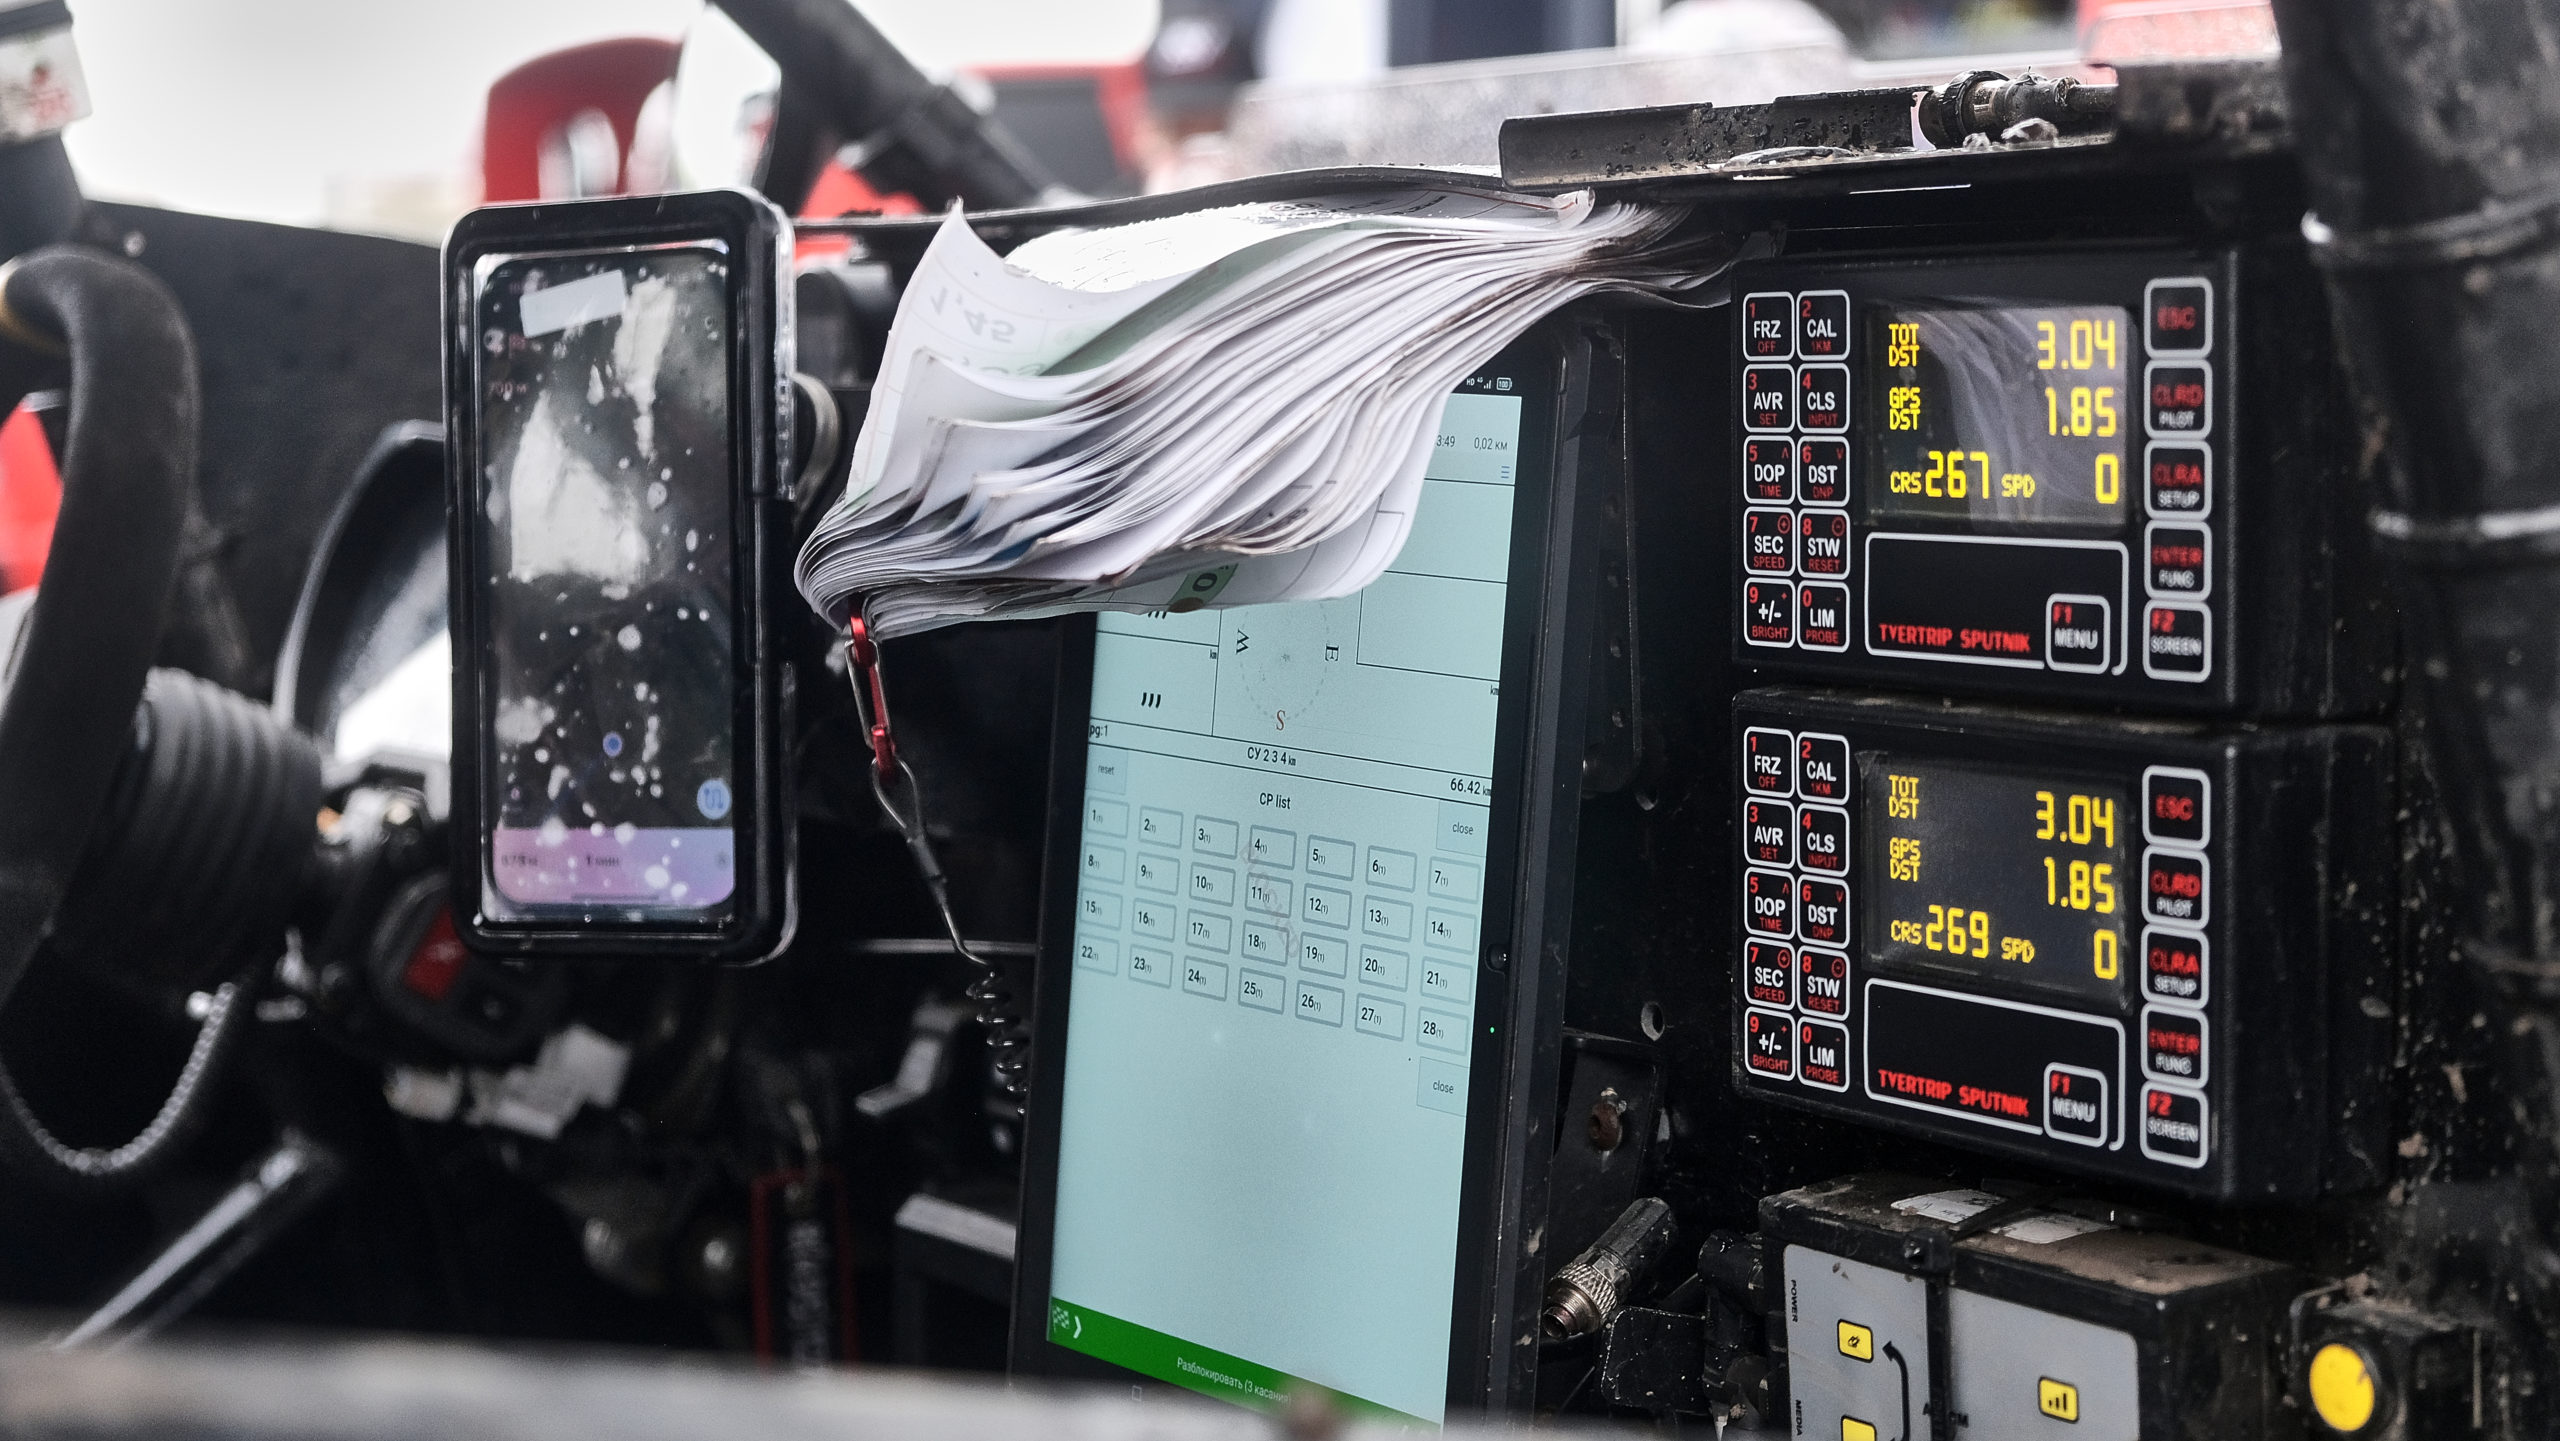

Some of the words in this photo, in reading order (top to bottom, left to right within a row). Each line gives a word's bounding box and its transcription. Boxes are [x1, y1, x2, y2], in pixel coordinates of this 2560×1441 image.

[1750, 303, 1756, 318] 1
[1802, 300, 1812, 318] 2
[1754, 320, 1781, 338] FRZ
[1807, 318, 1837, 338] CAL
[1888, 323, 1920, 345] TOT
[1758, 340, 1776, 353] OFF
[1812, 340, 1832, 352] 1KM
[2036, 319, 2116, 370] 3.04
[1888, 345, 1920, 367] DST
[1748, 373, 1758, 390] 3
[1802, 372, 1812, 390] 4
[1754, 392, 1783, 410] AVR
[1807, 392, 1835, 410] CLS
[1889, 386, 1921, 408] GPS
[1759, 413, 1778, 425] SET
[1808, 414, 1838, 426] INPUT
[1889, 408, 1921, 430] DST
[2044, 386, 2116, 437] 1.85
[2158, 410, 2195, 428] PILOT
[1474, 437, 1493, 451] 0,02
[1749, 445, 1758, 462] 5
[1802, 445, 1812, 463] 6
[1754, 464, 1785, 482] DOP
[1808, 465, 1838, 484] DST
[1890, 471, 1922, 494] CRS
[1925, 450, 1989, 499] 267
[2001, 473, 2036, 498] SPD
[2094, 453, 2119, 504] 0
[1759, 484, 1782, 497] TIME
[1813, 486, 1834, 498] DNP
[2158, 490, 2200, 508] SETUP
[1750, 516, 1758, 532] 7
[1803, 518, 1812, 536] 8
[1754, 535, 1784, 554] SEC
[1808, 537, 1840, 557] STW
[1754, 556, 1785, 568] SPEED
[2152, 546, 2203, 566] ENTER
[1808, 559, 1840, 572] RESET
[2158, 570, 2195, 588] FUNC
[1749, 586, 1758, 604] 9
[1810, 608, 1834, 628] LIM
[2052, 602, 2072, 624] F1
[2152, 609, 2175, 632] F2
[1752, 626, 1789, 639] BRIGHT
[1806, 630, 1838, 643] PROBE
[1879, 623, 1952, 646] TVERTRIP
[1960, 628, 2030, 652] SPUTNIK
[2054, 627, 2098, 650] MENU
[2151, 635, 2202, 656] SCREEN
[1276, 709, 1286, 731] S
[1088, 724, 1108, 739] pg:1
[1750, 736, 1756, 752] 1
[1802, 741, 1812, 758] 2
[1098, 764, 1114, 776] reset
[1754, 755, 1782, 775] FRZ
[1807, 760, 1836, 782] CAL
[1450, 778, 1480, 795] 66.42
[1758, 776, 1776, 788] OFF
[1811, 783, 1832, 794] 1KM
[1889, 774, 1919, 798] TOT
[1260, 792, 1274, 806] CP
[1276, 794, 1291, 810] list
[1889, 796, 1919, 820] DST
[2155, 794, 2194, 822] ESC
[1750, 806, 1758, 822] 3
[1802, 813, 1812, 830] 4
[2036, 790, 2114, 848] 3.04
[1452, 822, 1474, 836] close
[1754, 826, 1783, 846] AVR
[1807, 832, 1835, 854] CLS
[1889, 837, 1920, 861] GPS
[1760, 847, 1778, 860] SET
[1808, 855, 1838, 868] INPUT
[1890, 858, 1920, 882] DST
[1750, 877, 1758, 894] 5
[2044, 856, 2115, 914] 1.85
[2151, 869, 2201, 898] CLRD
[1802, 884, 1812, 902] 6
[1755, 896, 1786, 916] DOP
[1808, 904, 1838, 926] DST
[2156, 897, 2193, 917] PILOT
[1759, 917, 1782, 932] TIME
[1812, 926, 1834, 940] DNP
[1890, 920, 1922, 945] CRS
[1926, 904, 1989, 959] 269
[2001, 936, 2035, 963] SPD
[2094, 928, 2118, 980] 0
[1750, 946, 1759, 963] 7
[2150, 948, 2198, 975] CLRA
[1802, 955, 1812, 973] 8
[1754, 967, 1784, 988] SEC
[2154, 974, 2196, 996] SETUP
[1754, 987, 1786, 1002] SPEED
[1808, 976, 1840, 998] STW
[1808, 996, 1840, 1012] RESET
[1750, 1016, 1759, 1033] 9
[2149, 1028, 2200, 1054] ENTER
[1752, 1054, 1789, 1072] BRIGHT
[1809, 1045, 1835, 1068] LIM
[2155, 1052, 2192, 1075] FUNC
[1806, 1066, 1839, 1084] PROBE
[2051, 1073, 2070, 1095] F1
[1432, 1079, 1454, 1096] close
[1878, 1069, 1952, 1100] TVERTRIP
[1959, 1085, 2029, 1118] SPUTNIK
[2052, 1096, 2096, 1122] MENU
[2149, 1090, 2172, 1116] F2
[2148, 1116, 2198, 1142] SCREEN
[1791, 1280, 1799, 1323] POWER
[1177, 1357, 1243, 1389] Разблокировать
[1795, 1399, 1803, 1436] MEDIA
